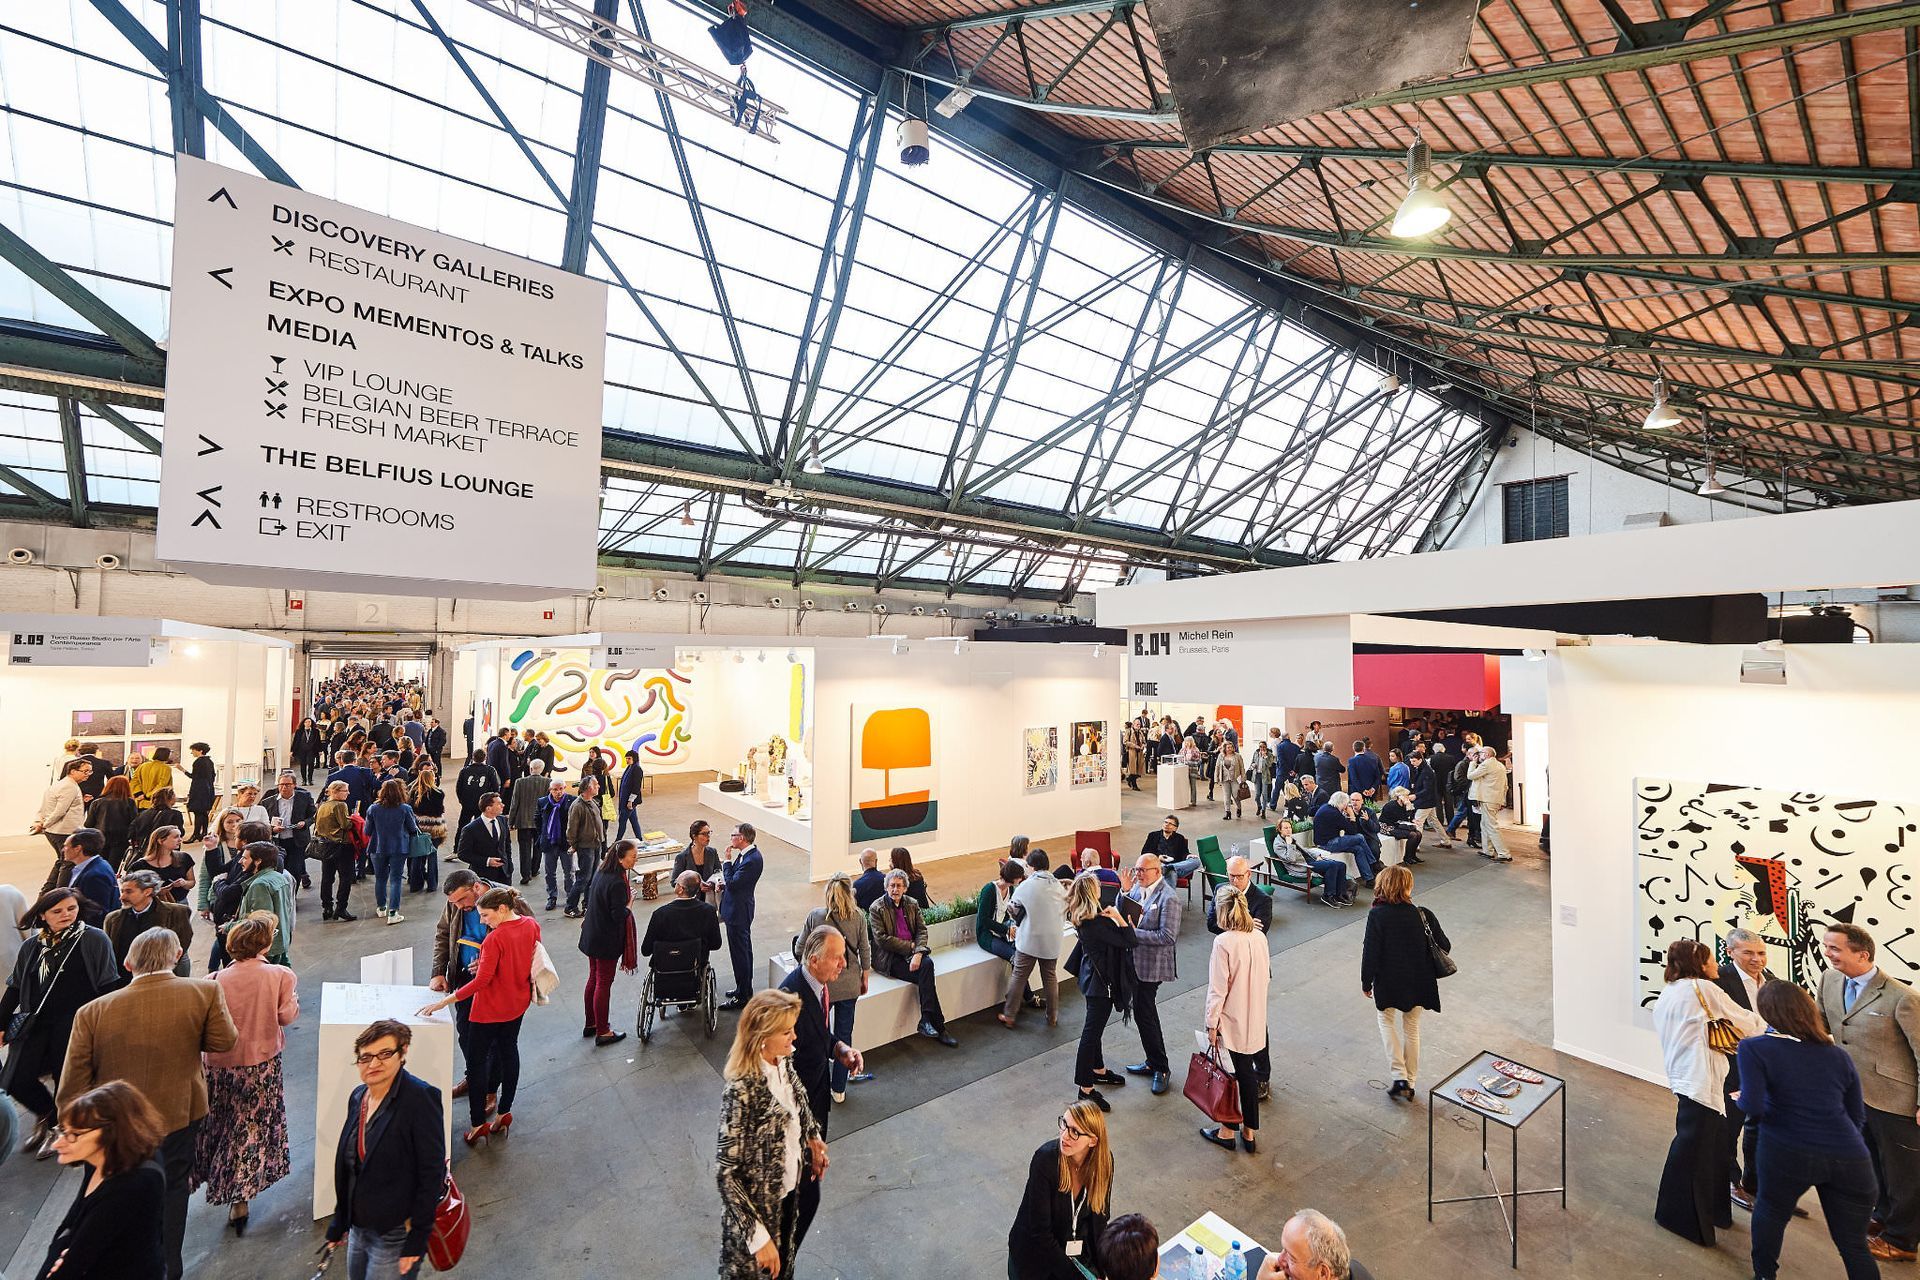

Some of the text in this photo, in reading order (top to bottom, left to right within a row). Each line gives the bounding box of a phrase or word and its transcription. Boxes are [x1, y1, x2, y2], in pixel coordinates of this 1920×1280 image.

[272, 204, 555, 300] DISCOVERY GALLERIES
[309, 246, 471, 304] RESTAURANT
[268, 314, 357, 350] MEDIA
[269, 280, 584, 370] EXPO MEMENTOS & TALKS
[304, 360, 453, 405] VIP LOUNGE
[302, 407, 488, 454] FRESH MARKET
[304, 383, 579, 448] BELGIAN BEER TERRACE
[260, 445, 534, 499] THE BELFIUS LOUNGE
[296, 521, 352, 541] EXIT
[297, 497, 455, 531] RESTROOMS
[364, 603, 380, 624] 2
[14, 634, 44, 645] B.09
[1134, 632, 1170, 656] B.04
[1178, 629, 1234, 641] Michel Rein
[1178, 644, 1230, 654] Brussels, Paris
[1134, 682, 1158, 696] PRIME
